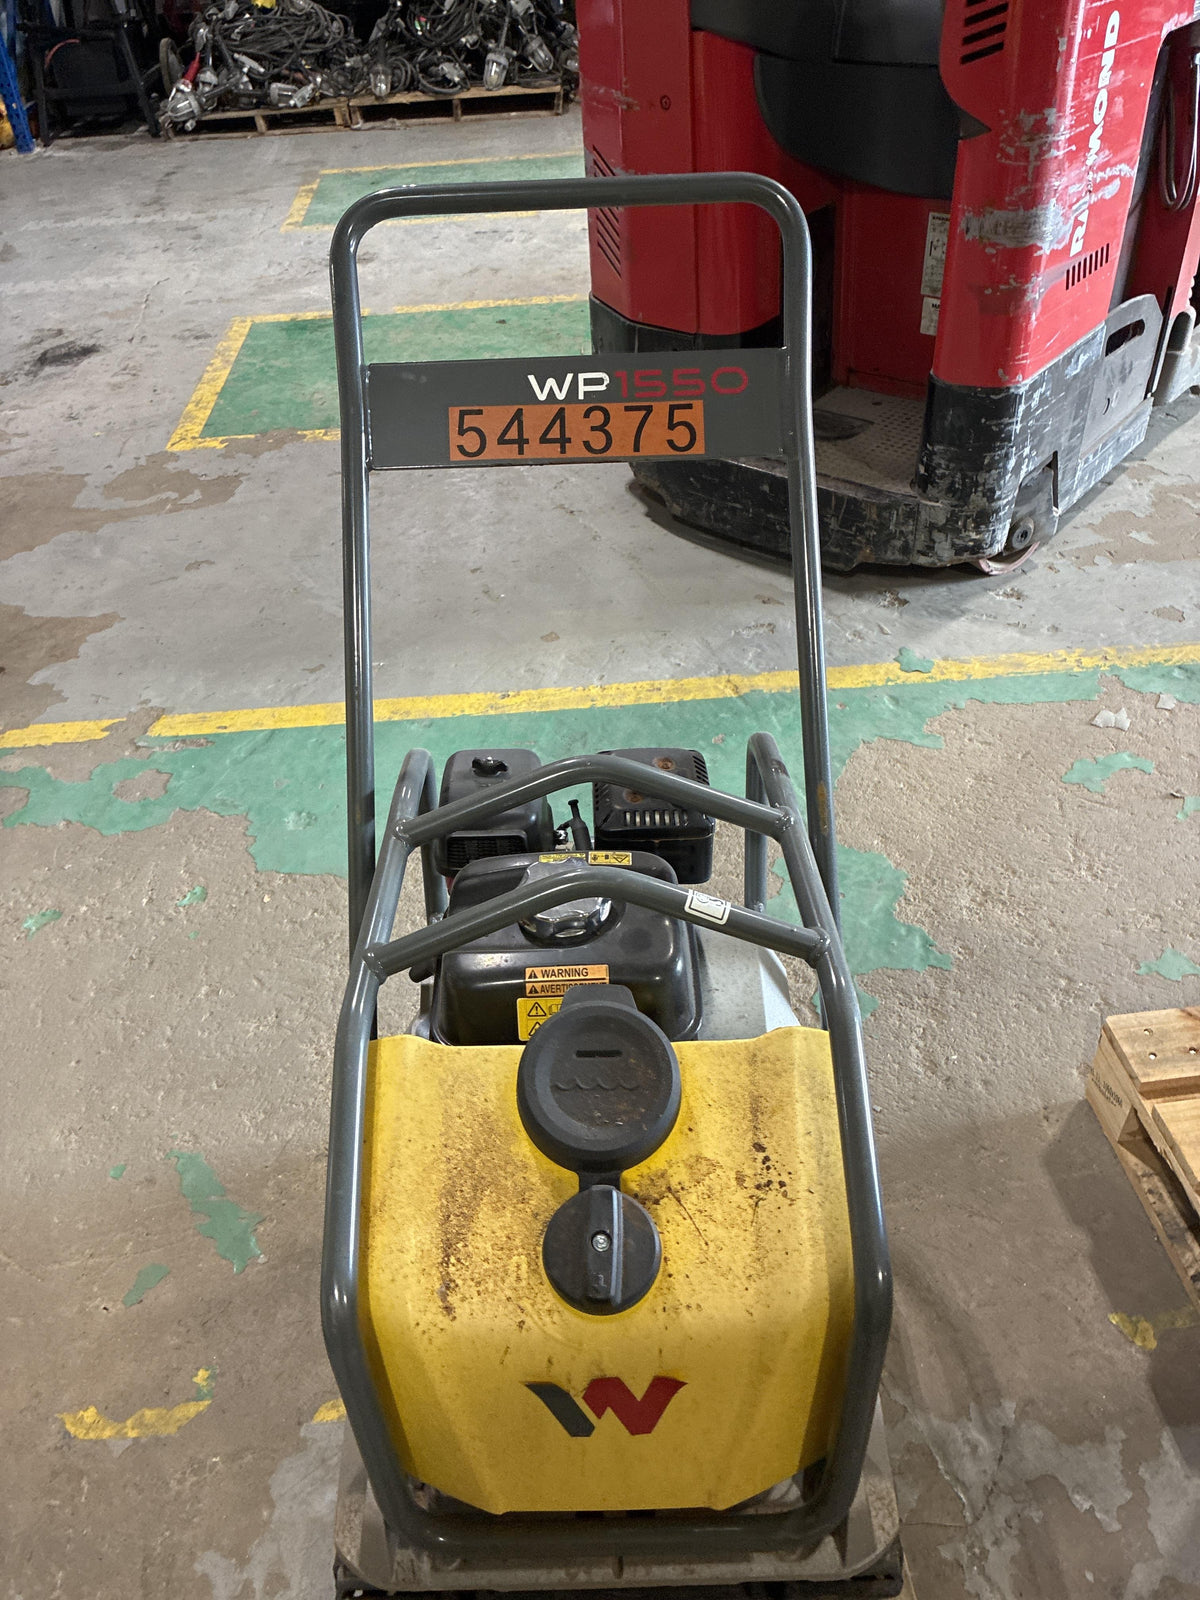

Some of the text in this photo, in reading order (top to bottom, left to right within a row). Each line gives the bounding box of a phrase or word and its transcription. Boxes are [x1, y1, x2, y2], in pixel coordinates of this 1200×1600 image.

[1069, 10, 1120, 257] RAMOND
[527, 366, 749, 401] WP1550
[456, 403, 697, 458] 544375
[541, 968, 588, 978] WARNING
